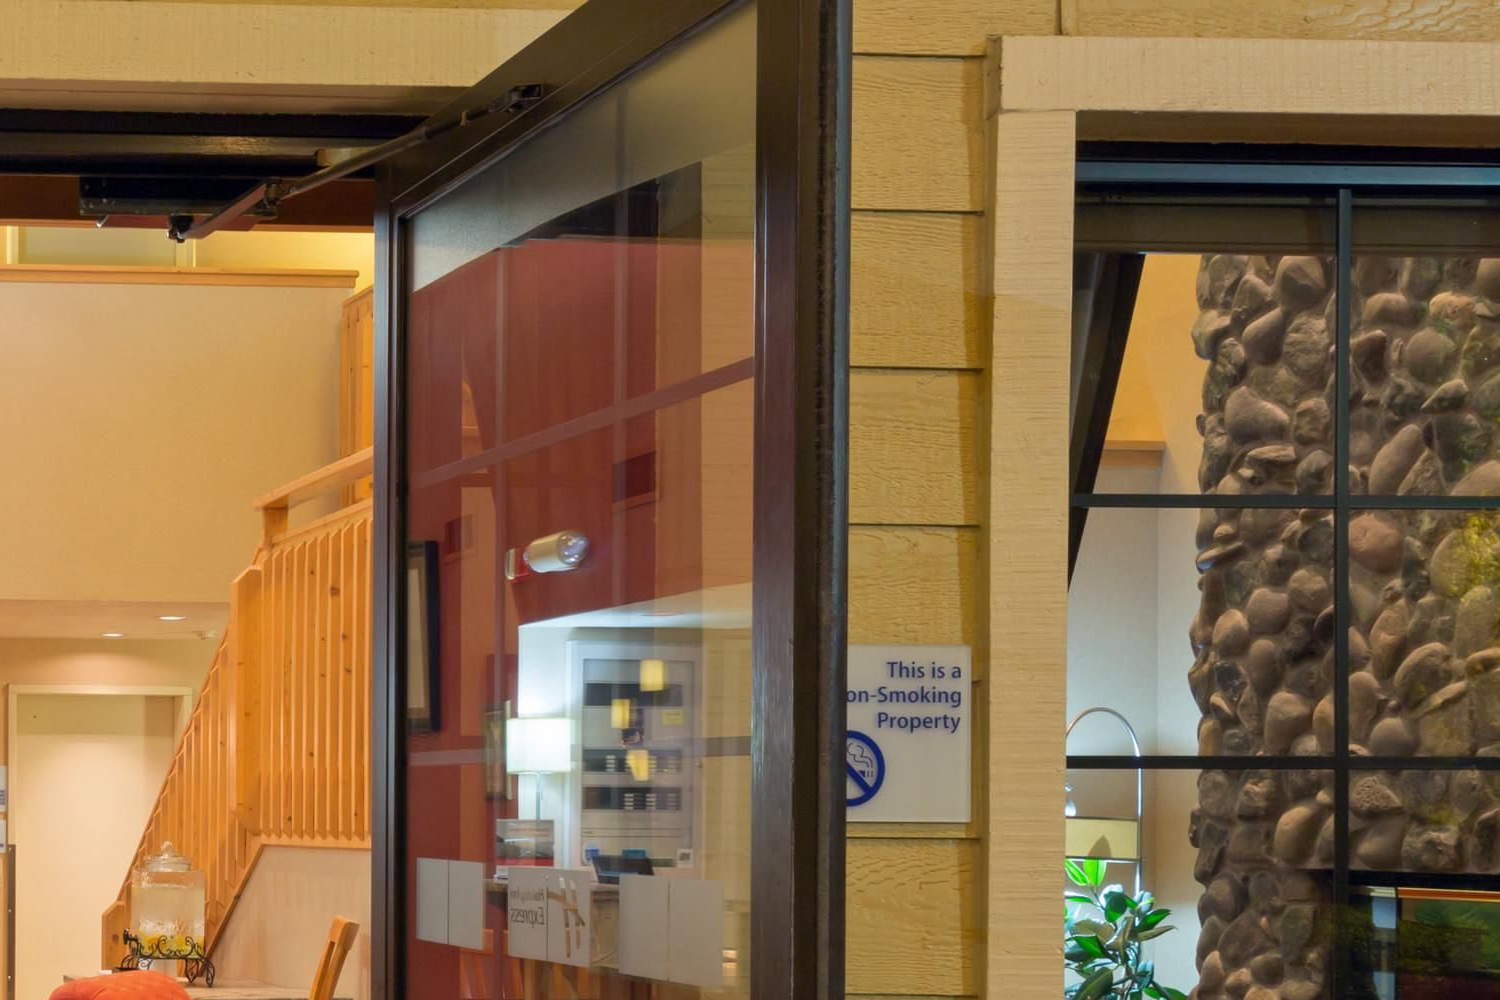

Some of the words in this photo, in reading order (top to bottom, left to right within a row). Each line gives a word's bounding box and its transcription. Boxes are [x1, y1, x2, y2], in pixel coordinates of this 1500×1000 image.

[886, 661, 925, 679] This
[931, 661, 945, 679] is
[951, 666, 961, 679] a
[846, 686, 961, 708] on-Smoking
[877, 712, 961, 734] Property
